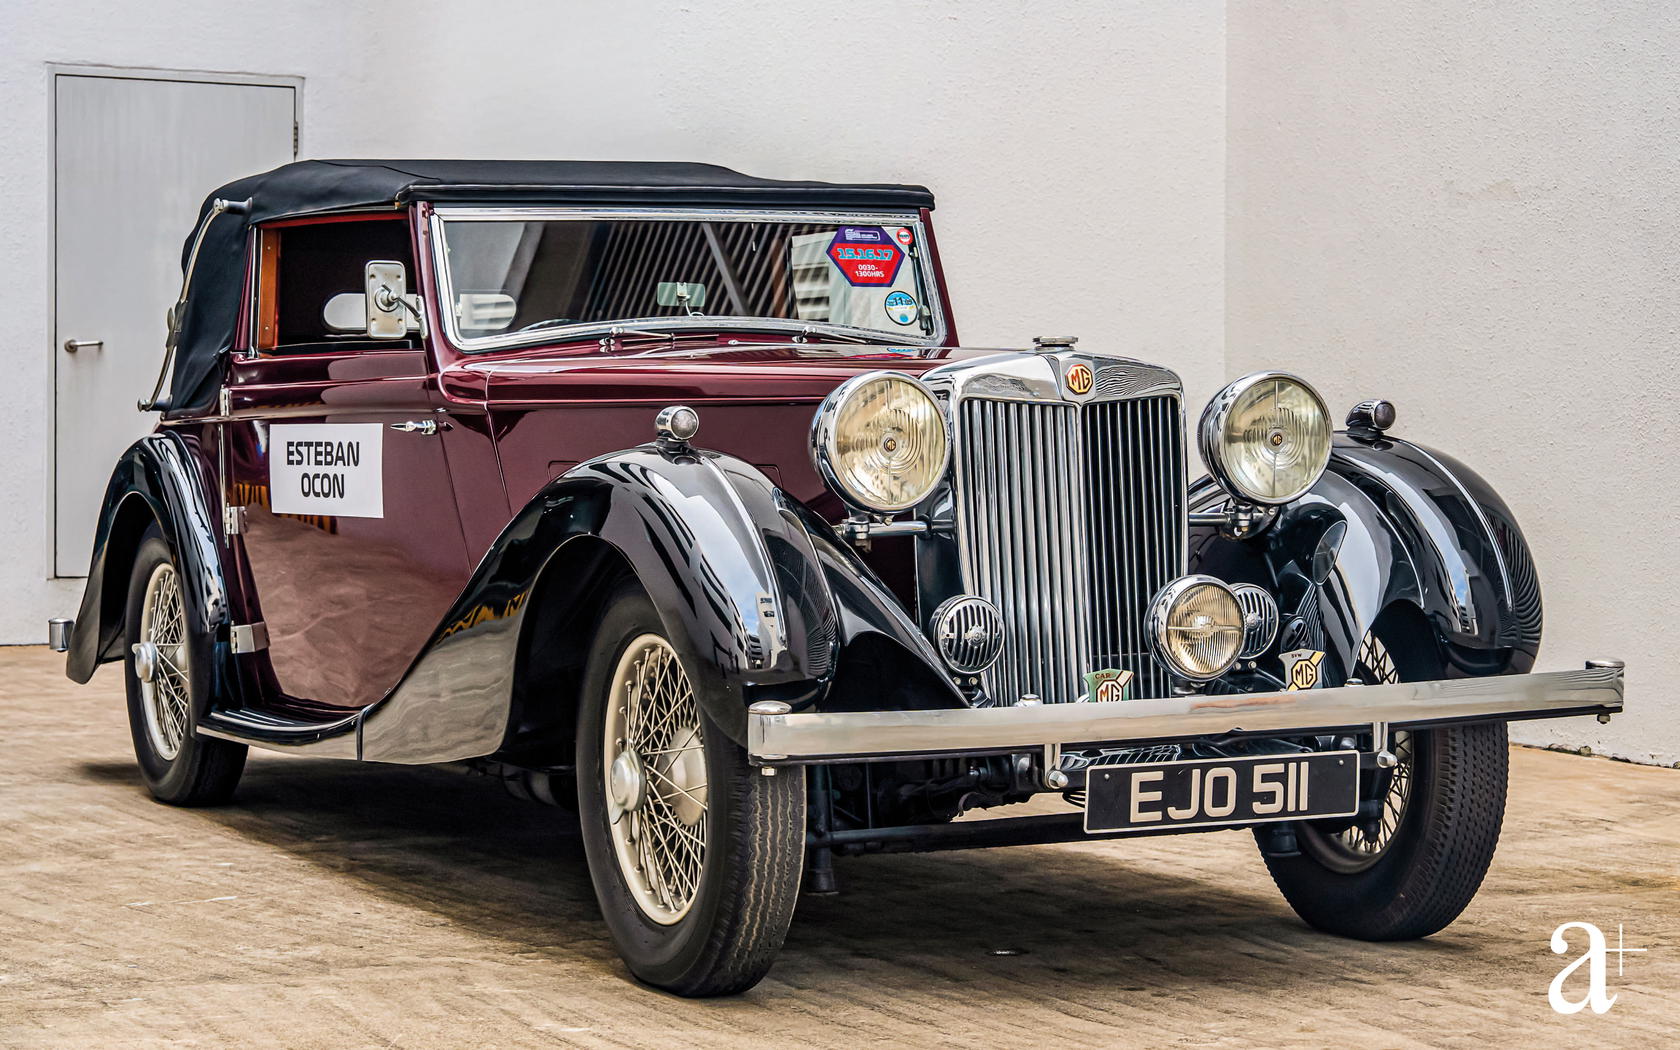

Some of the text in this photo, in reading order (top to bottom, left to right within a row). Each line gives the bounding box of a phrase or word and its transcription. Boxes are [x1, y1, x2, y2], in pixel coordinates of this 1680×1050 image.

[1071, 368, 1091, 390] MG
[286, 441, 360, 467] ESTEBAN
[301, 472, 345, 499] OCON
[1295, 663, 1314, 685] MG
[1100, 684, 1120, 702] MG
[1130, 761, 1309, 823] EJO 511
